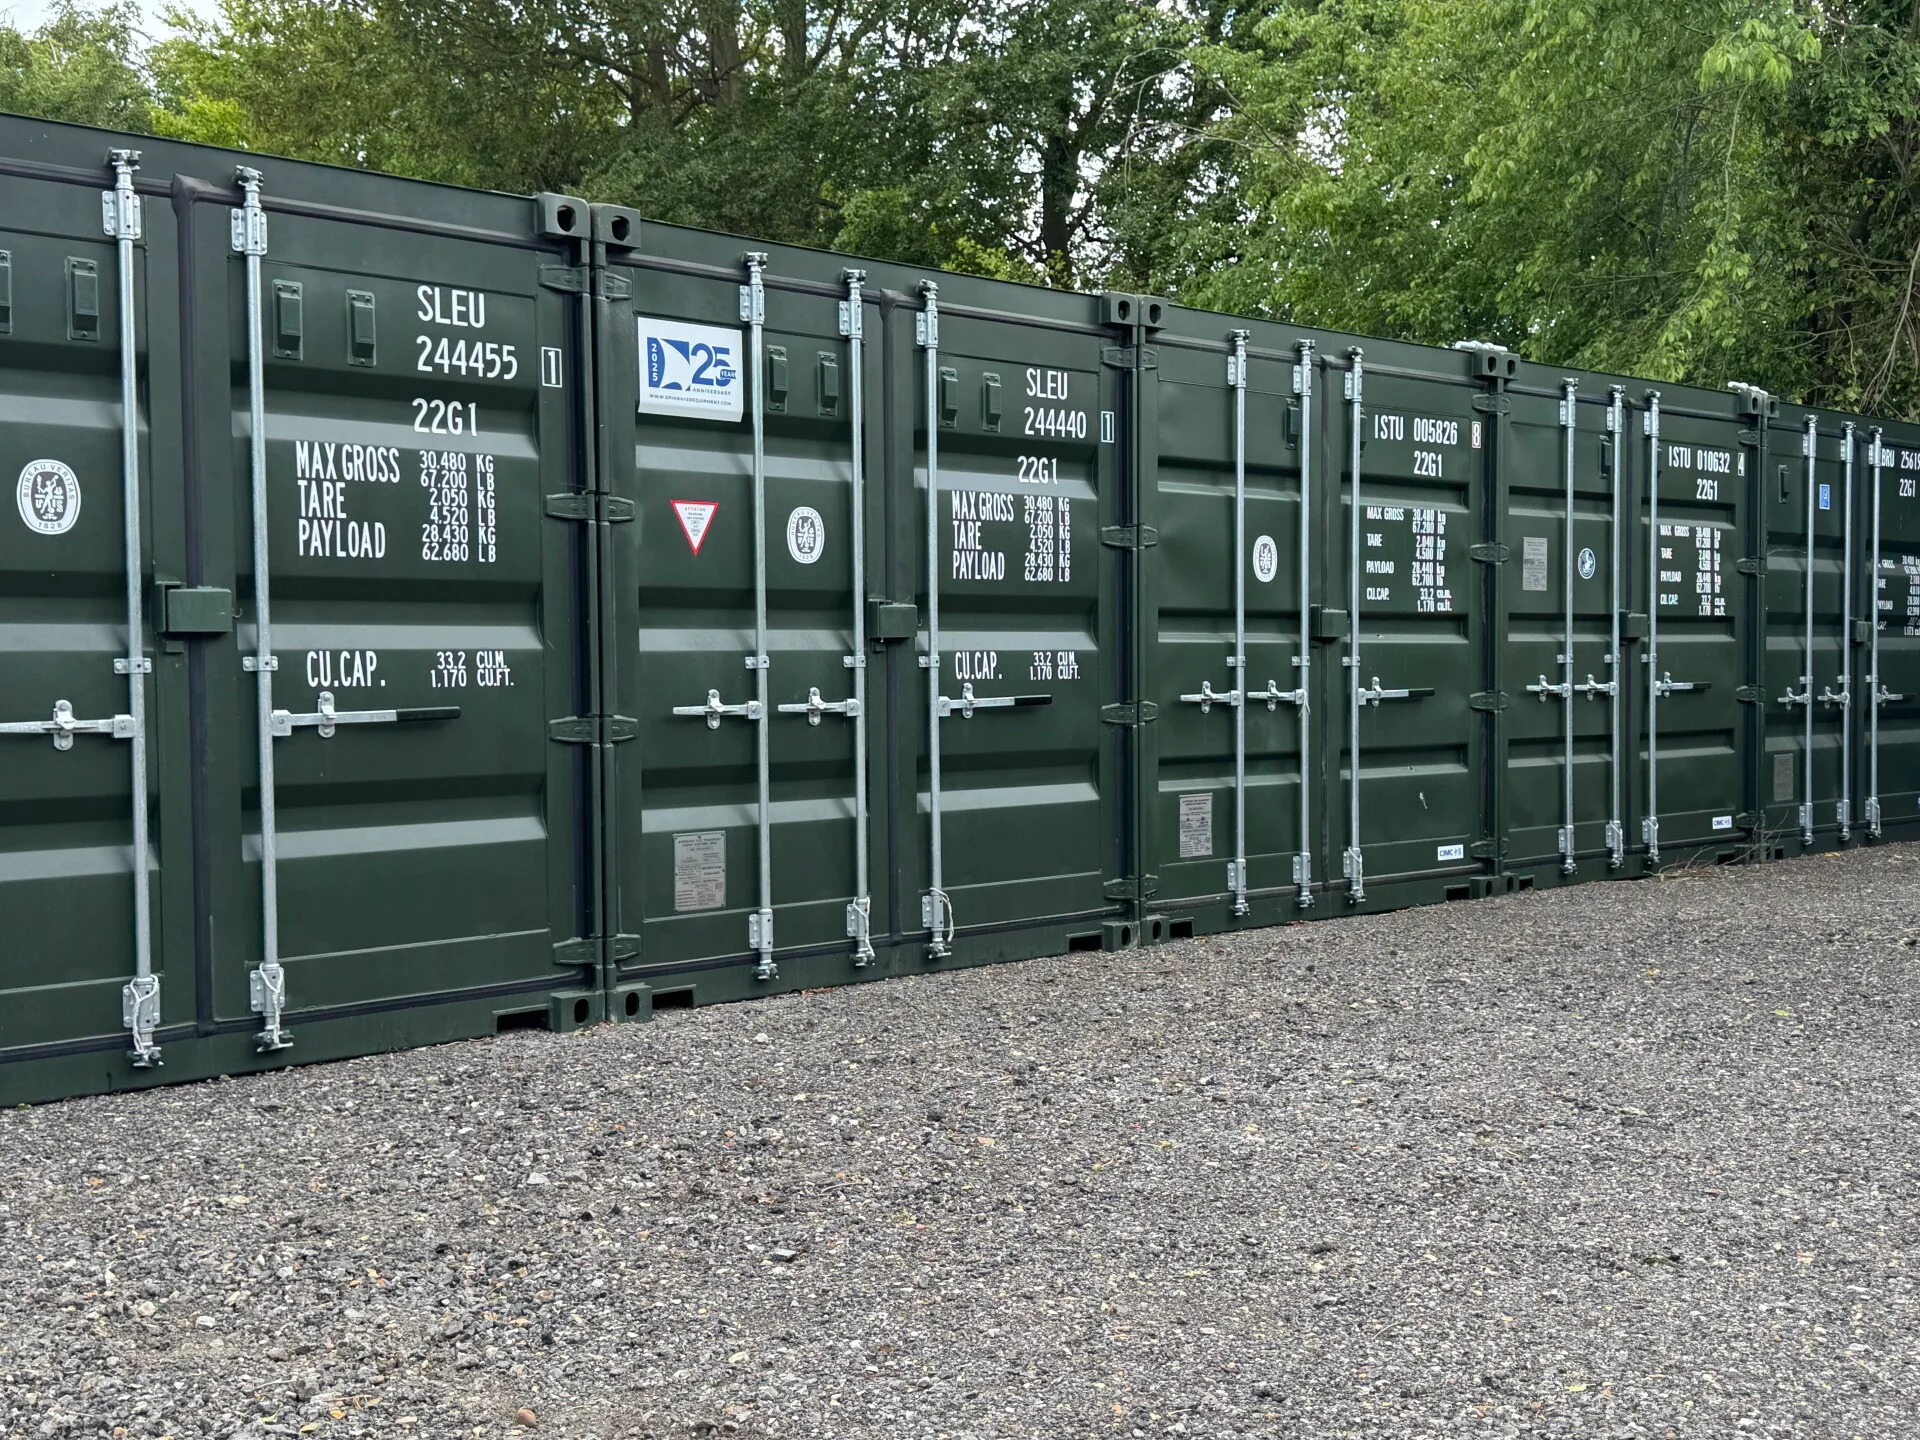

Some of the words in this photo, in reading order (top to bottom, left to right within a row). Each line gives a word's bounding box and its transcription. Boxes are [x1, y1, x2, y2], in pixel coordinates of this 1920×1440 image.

[417, 285, 485, 328] SLEU
[416, 335, 518, 380] 244455
[651, 343, 659, 382] 2025
[691, 343, 731, 387] 25
[692, 387, 731, 396] ANNIVERSARY
[1026, 368, 1067, 400] SLEU
[412, 398, 477, 437] 22G1
[1024, 407, 1087, 439] 244440
[1374, 414, 1404, 440] ISTU
[1413, 418, 1458, 445] 005826
[295, 440, 338, 480] MAX
[342, 444, 400, 483] GROSS
[419, 450, 466, 470] 30.480
[476, 454, 494, 472] KG
[1017, 455, 1058, 485] 22G1
[1413, 450, 1442, 477] 22G1
[1668, 446, 1690, 468] ISTU
[1697, 450, 1730, 473] 010632
[1738, 453, 1744, 476] 4
[23, 464, 46, 498] BUREAU
[51, 465, 75, 499] VERITAS
[420, 469, 467, 488] 67.200
[477, 472, 494, 490] LB
[1696, 478, 1718, 500] 22G1
[1900, 478, 1916, 498] 22G1
[297, 480, 347, 519] TARE
[429, 488, 468, 507] 2.050
[478, 491, 495, 508] KG
[952, 490, 977, 520] MAX
[978, 492, 1014, 521] GROSS
[1023, 495, 1053, 510] 30.480
[1058, 497, 1070, 511] KG
[430, 507, 468, 525] 4.520
[478, 508, 495, 526] LB
[1024, 509, 1053, 525] 67.200
[1059, 511, 1070, 526] LB
[1366, 506, 1382, 519] MAX
[1384, 507, 1404, 520] GROSS
[1412, 509, 1434, 522] 30.480
[1438, 510, 1446, 524] kg
[422, 524, 468, 544] 28.430
[478, 526, 496, 544] KG
[953, 521, 982, 550] TARE
[1030, 524, 1054, 538] 2.050
[1059, 525, 1070, 540] KG
[1412, 521, 1434, 534] 67.200
[1660, 525, 1672, 536] MAX
[1674, 526, 1690, 537] GROSS
[299, 519, 386, 559] PAYLOAD
[1030, 538, 1054, 553] 4.520
[1059, 539, 1070, 554] LB
[1367, 533, 1382, 546] TARE
[1416, 536, 1434, 548] 2.040
[1437, 536, 1446, 551] kg
[422, 543, 469, 561] 62.680
[479, 544, 496, 562] LB
[1024, 552, 1054, 567] 28.430
[1059, 553, 1070, 568] KG
[1416, 547, 1434, 560] 4.500
[1661, 548, 1672, 559] TARE
[953, 551, 1005, 580] PAYLOAD
[1024, 567, 1054, 582] 62.680
[1059, 568, 1070, 582] LB
[1366, 560, 1394, 574] PAYLOAD
[1412, 562, 1434, 574] 28.440
[1436, 562, 1445, 577] kg
[1412, 574, 1434, 586] 62.700
[1660, 570, 1682, 582] PAYLOAD
[1420, 588, 1434, 600] 33.2
[1417, 600, 1434, 612] 1.170
[306, 650, 386, 687] CU.CAP.
[436, 651, 466, 670] 33.2
[476, 650, 508, 669] CU.M.
[955, 651, 1002, 680] CU.CAP.
[1033, 651, 1052, 666] 33.2
[430, 669, 467, 687] 1.170
[477, 668, 515, 686] CU.FT.
[1030, 666, 1052, 680] 1.170
